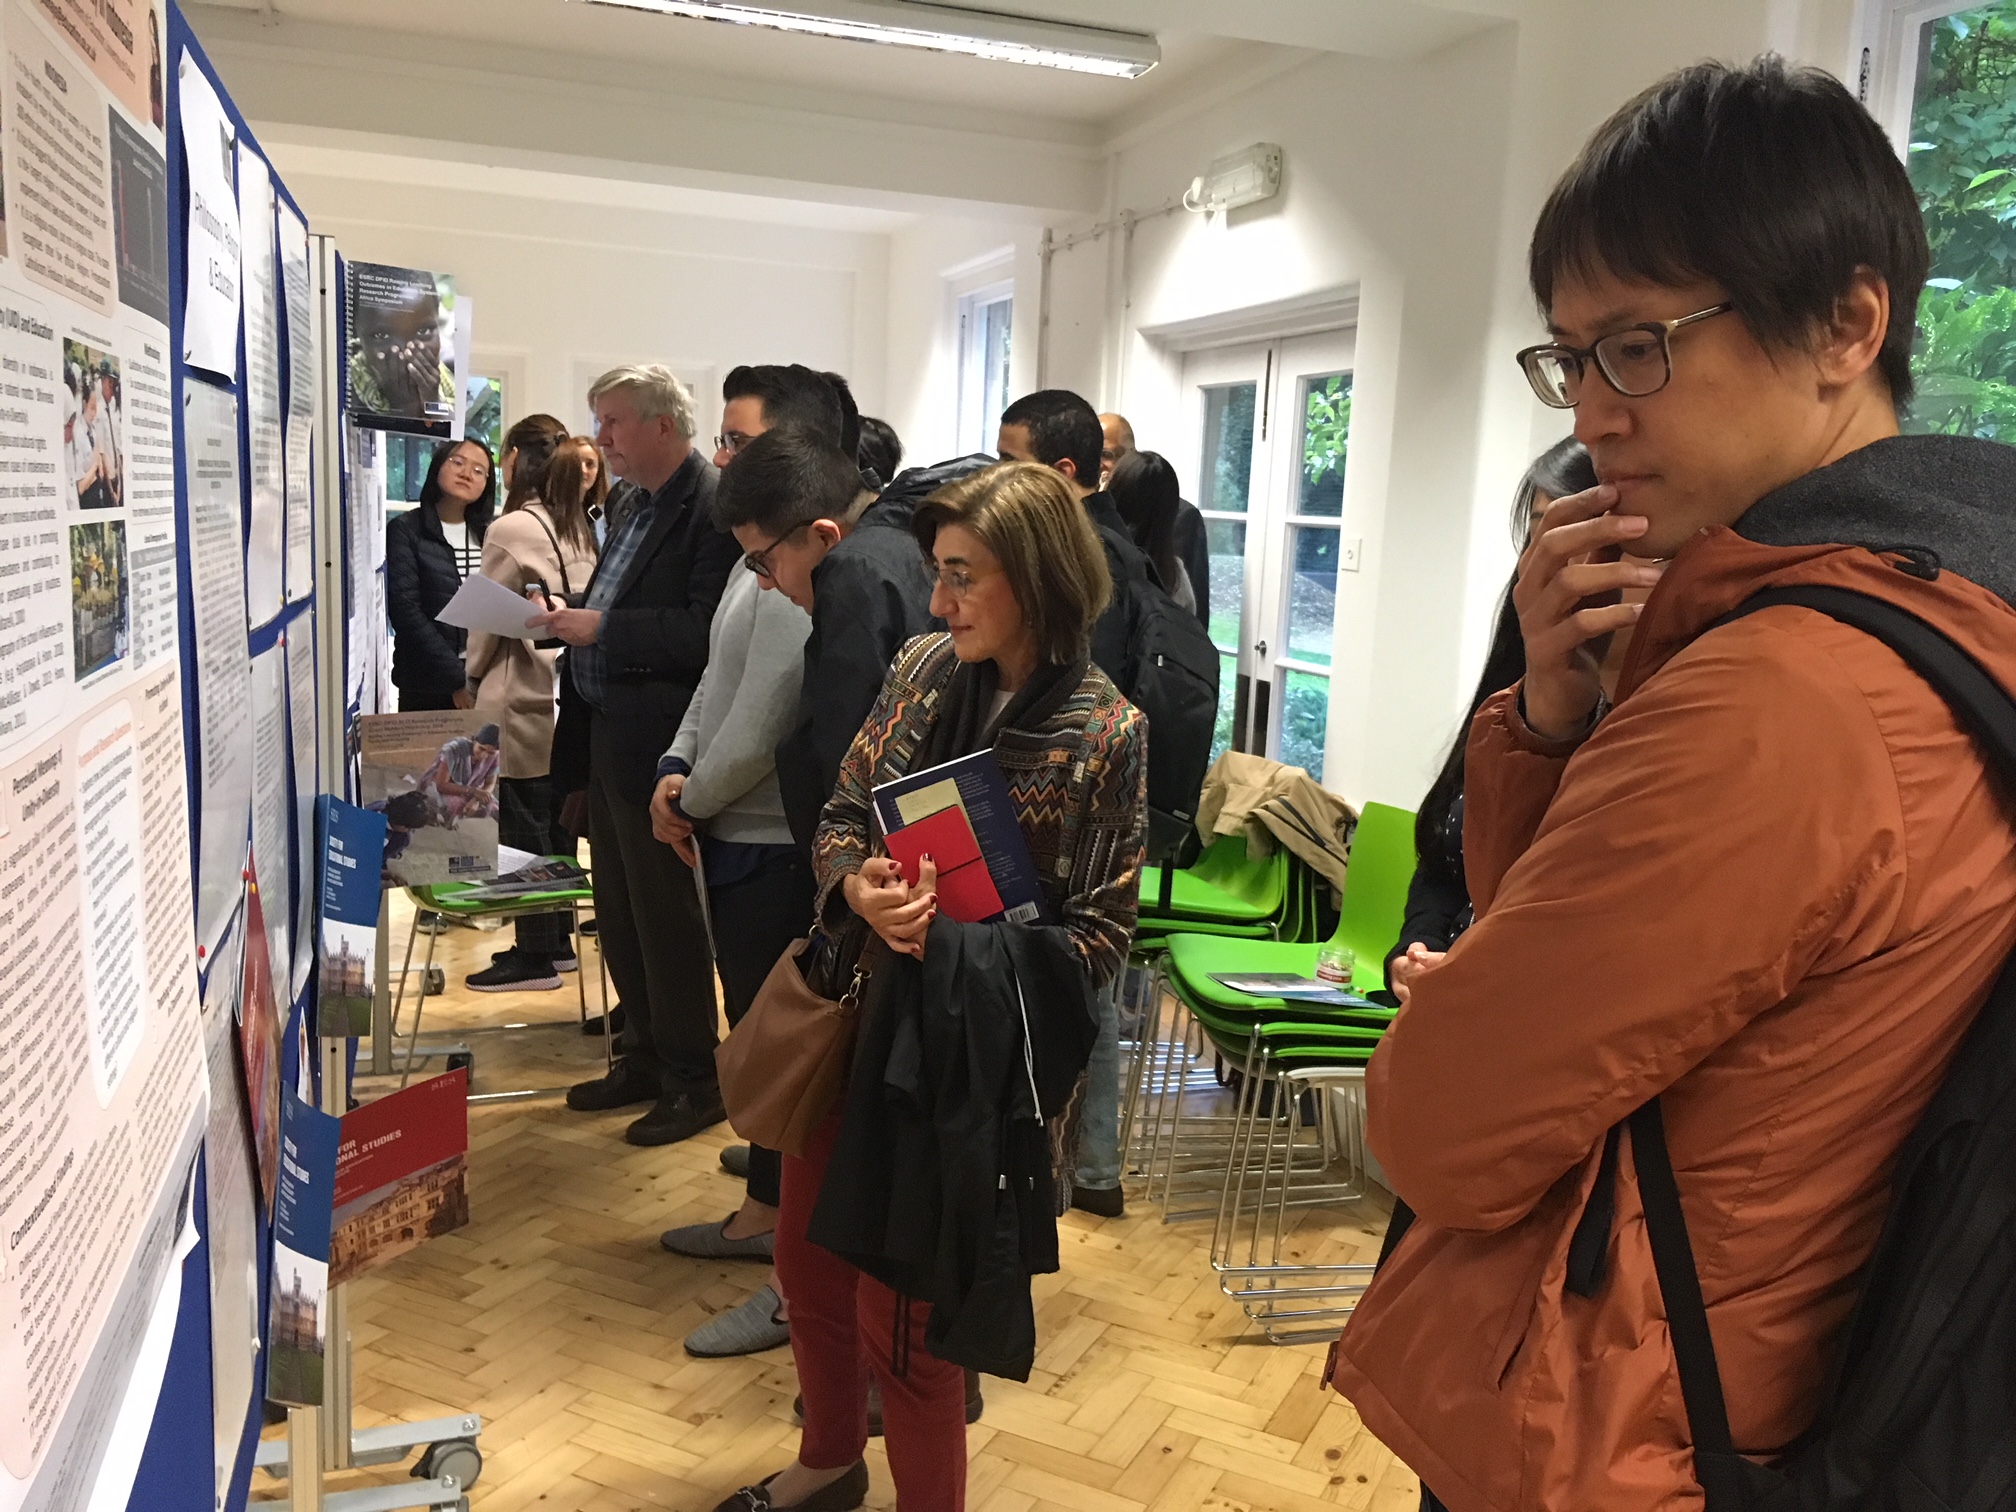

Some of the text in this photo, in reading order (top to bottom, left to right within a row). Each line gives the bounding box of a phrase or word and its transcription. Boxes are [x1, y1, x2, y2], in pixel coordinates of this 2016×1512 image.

[21, 315, 30, 333] and
[31, 317, 54, 341] Education
[13, 763, 37, 796] Perceived
[22, 779, 60, 821] Unity-in-Diversity
[9, 838, 31, 868] significant
[2, 869, 25, 899] appeared
[20, 1029, 44, 1065] differences
[18, 1056, 42, 1092] important
[20, 1077, 44, 1117] contextual
[336, 1130, 402, 1165] ONAL STUDIES
[338, 1139, 357, 1153] FOR
[11, 1147, 74, 1250] Contextualised Findings
